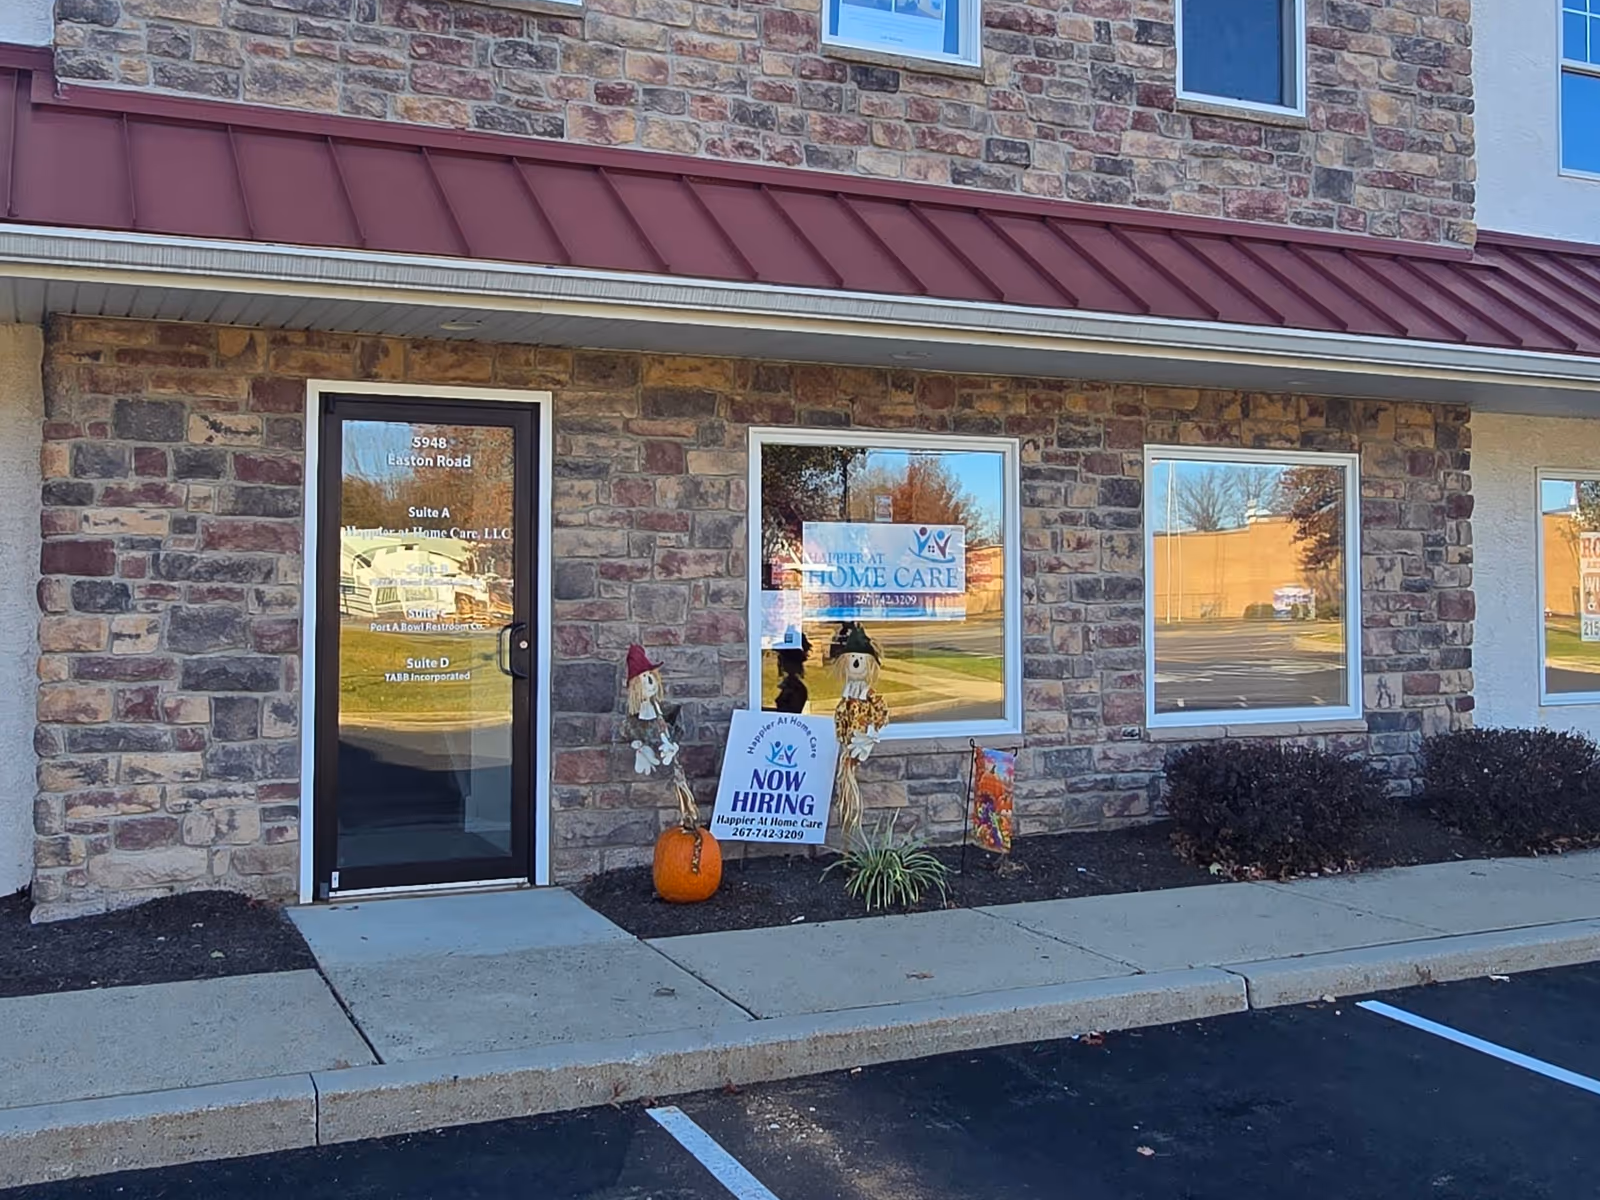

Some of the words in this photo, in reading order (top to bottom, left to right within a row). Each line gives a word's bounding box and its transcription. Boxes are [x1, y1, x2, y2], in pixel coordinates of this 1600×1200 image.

[411, 436, 448, 449] 5948
[387, 453, 434, 467] Easton
[436, 455, 472, 468] Road
[408, 506, 439, 518] Suite
[441, 507, 450, 518] A
[413, 527, 448, 538] Home
[450, 527, 481, 540] Care,
[484, 528, 511, 539] LLC
[867, 553, 885, 564] AT
[808, 566, 887, 588] HOME
[893, 567, 959, 588] CARE
[369, 622, 391, 632] Port
[392, 623, 400, 631] A
[401, 623, 424, 631] Bowl
[406, 657, 438, 669] Suite
[439, 657, 450, 668] D
[384, 673, 409, 682] TABB
[410, 671, 471, 683] Incorporated
[747, 722, 774, 754] Happier
[777, 716, 788, 725] At
[790, 716, 812, 737] Home
[809, 736, 817, 759] Care
[750, 768, 806, 792] NOW
[731, 791, 814, 815] HIRING
[716, 814, 755, 826] Happier
[757, 817, 768, 826] At
[770, 817, 798, 828] Home
[800, 818, 823, 829] Care
[732, 827, 804, 840] 267-742-3209
